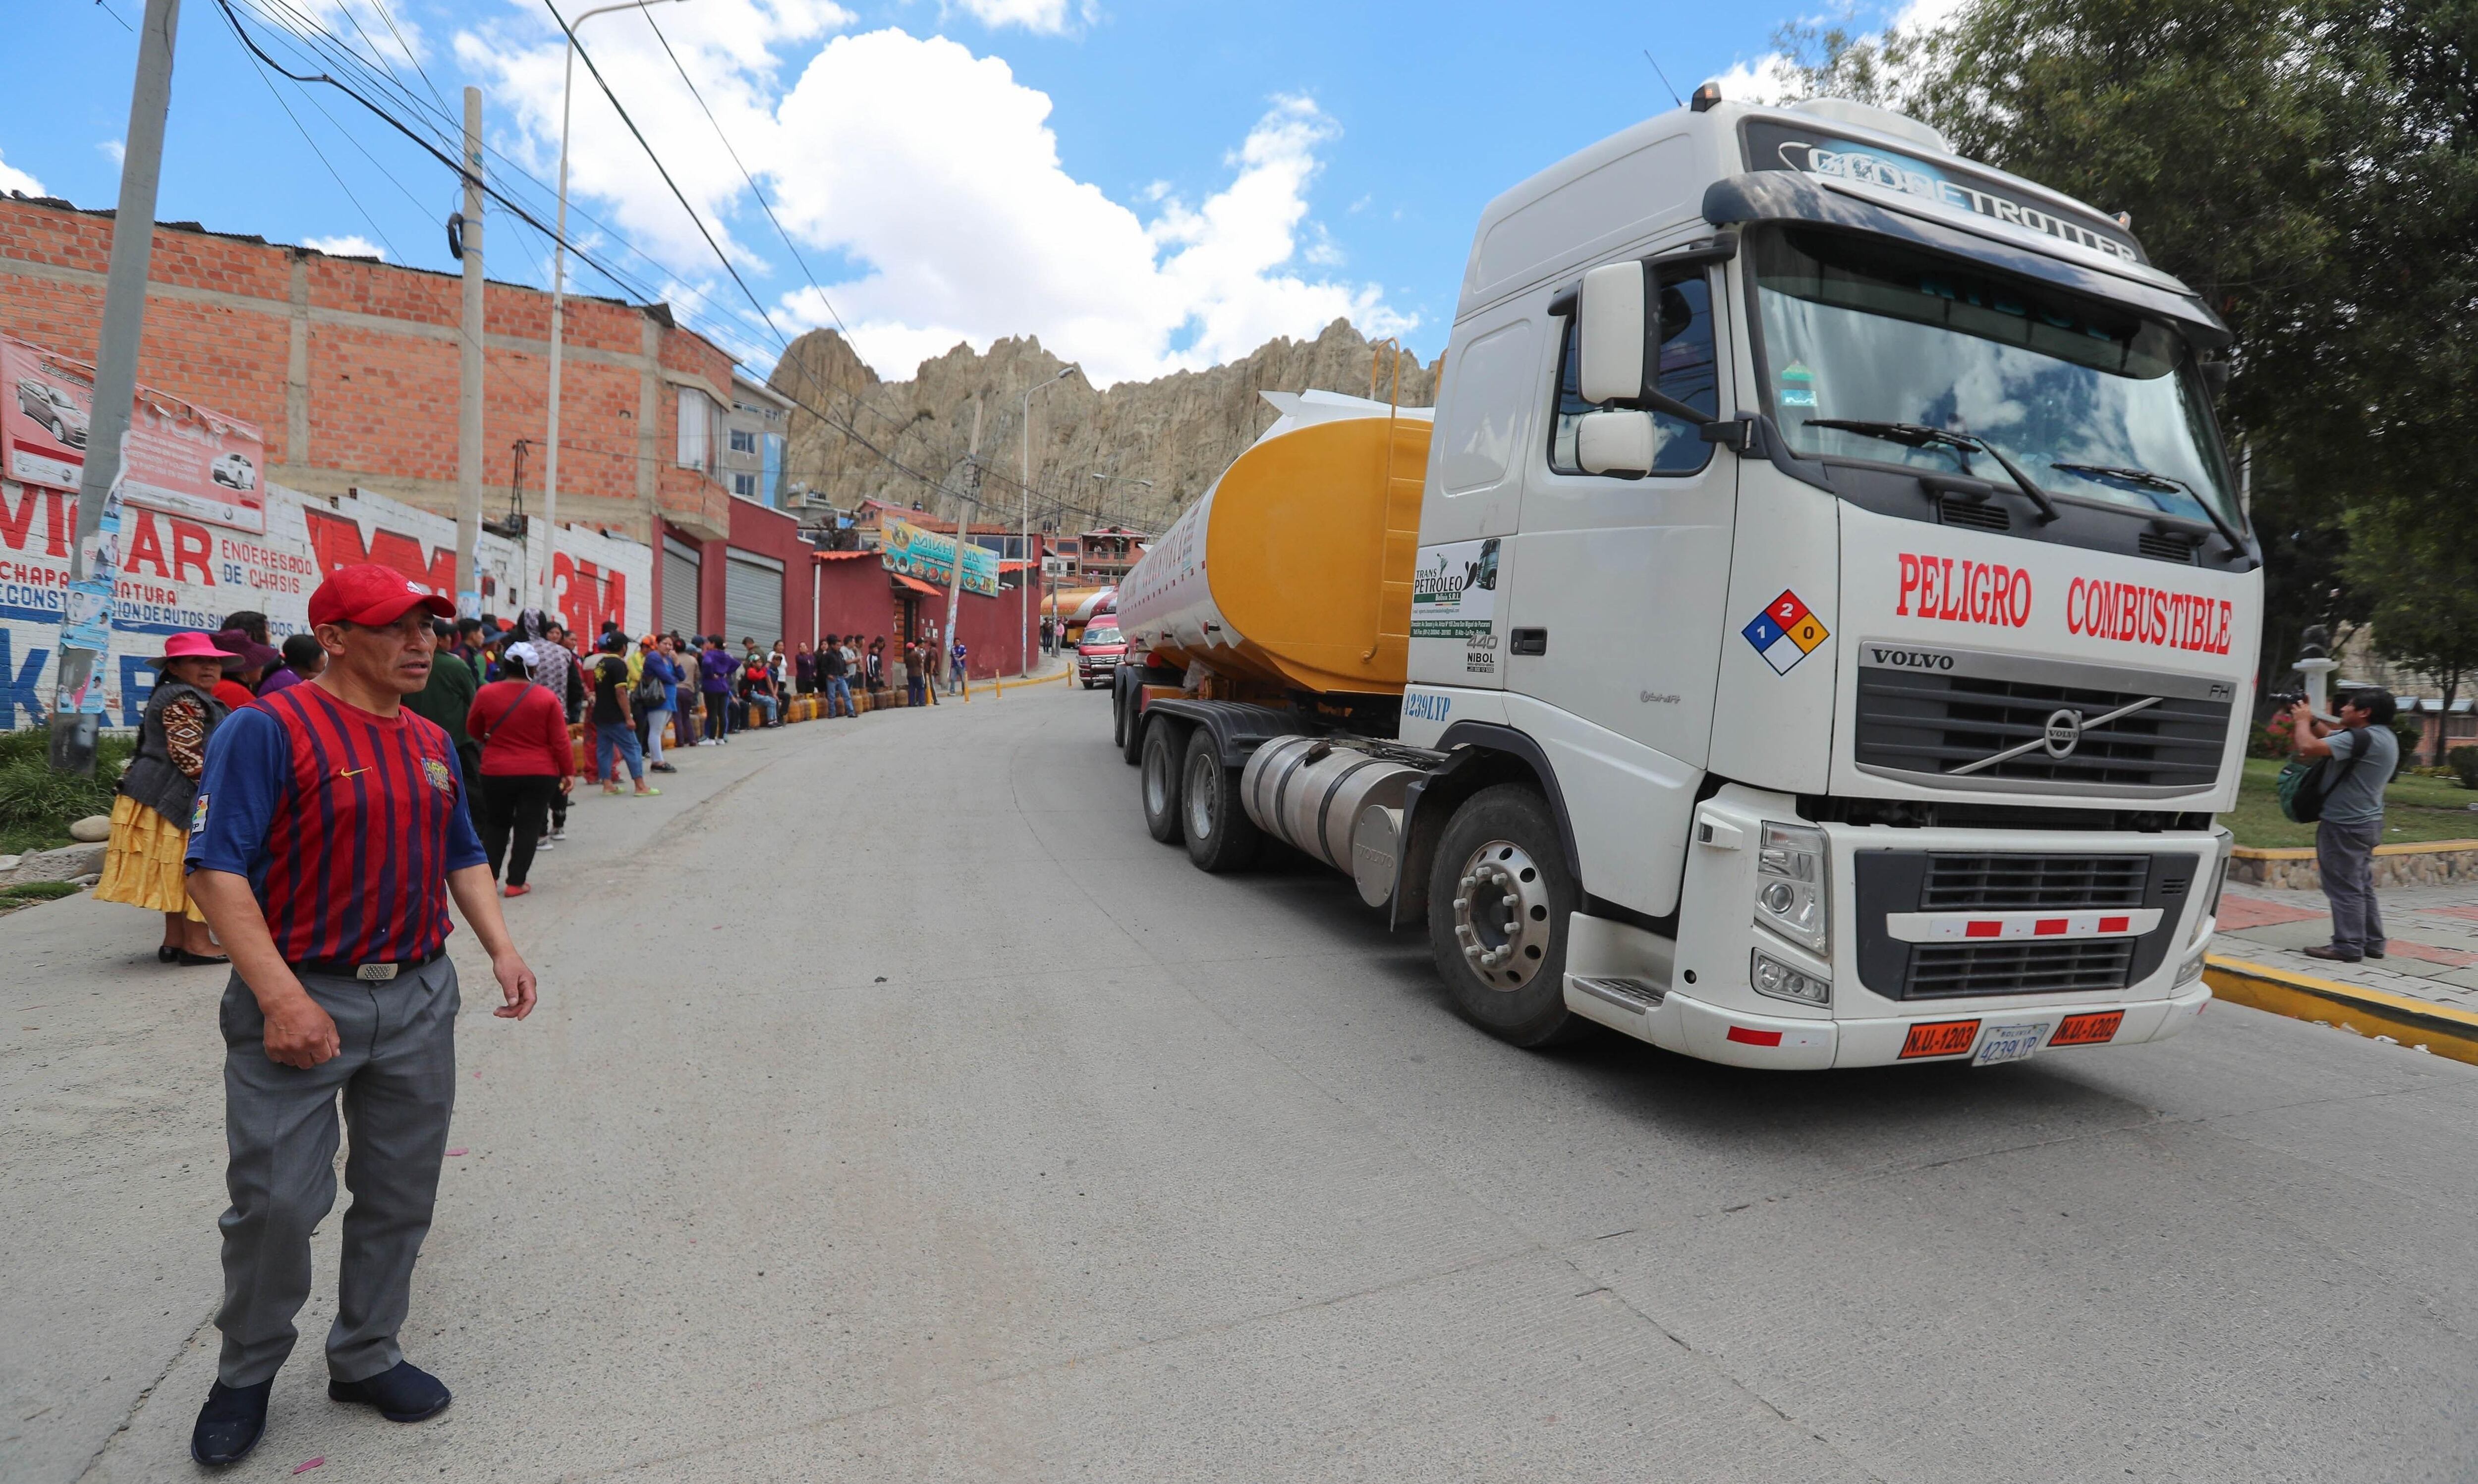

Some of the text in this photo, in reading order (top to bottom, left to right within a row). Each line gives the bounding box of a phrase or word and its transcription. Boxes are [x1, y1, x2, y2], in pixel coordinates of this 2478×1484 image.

[0, 482, 215, 586] VIAR
[222, 539, 312, 576] ENDERESADO
[224, 563, 300, 594] DE CHASIS
[1416, 568, 1437, 579] TRANS
[1414, 576, 1463, 593] PETROLEO
[1780, 603, 1794, 617] 2
[1896, 552, 2232, 655] PELIGRO COMBUSTIBLE
[144, 605, 160, 621] DE
[164, 608, 205, 628] AUTOS
[1466, 635, 1498, 649] 440
[1757, 626, 1814, 639] 1 0
[1467, 653, 1494, 663] NIBOL
[1871, 648, 1955, 671] VOLVO
[2209, 685, 2230, 699] FH
[1404, 693, 1451, 721] 4239LYP
[2049, 729, 2078, 738] VOLVO
[1905, 1027, 1972, 1054] N.U.-1203
[2001, 1029, 2031, 1038] BOLIVIA
[1980, 1036, 2037, 1063] 4239LYP
